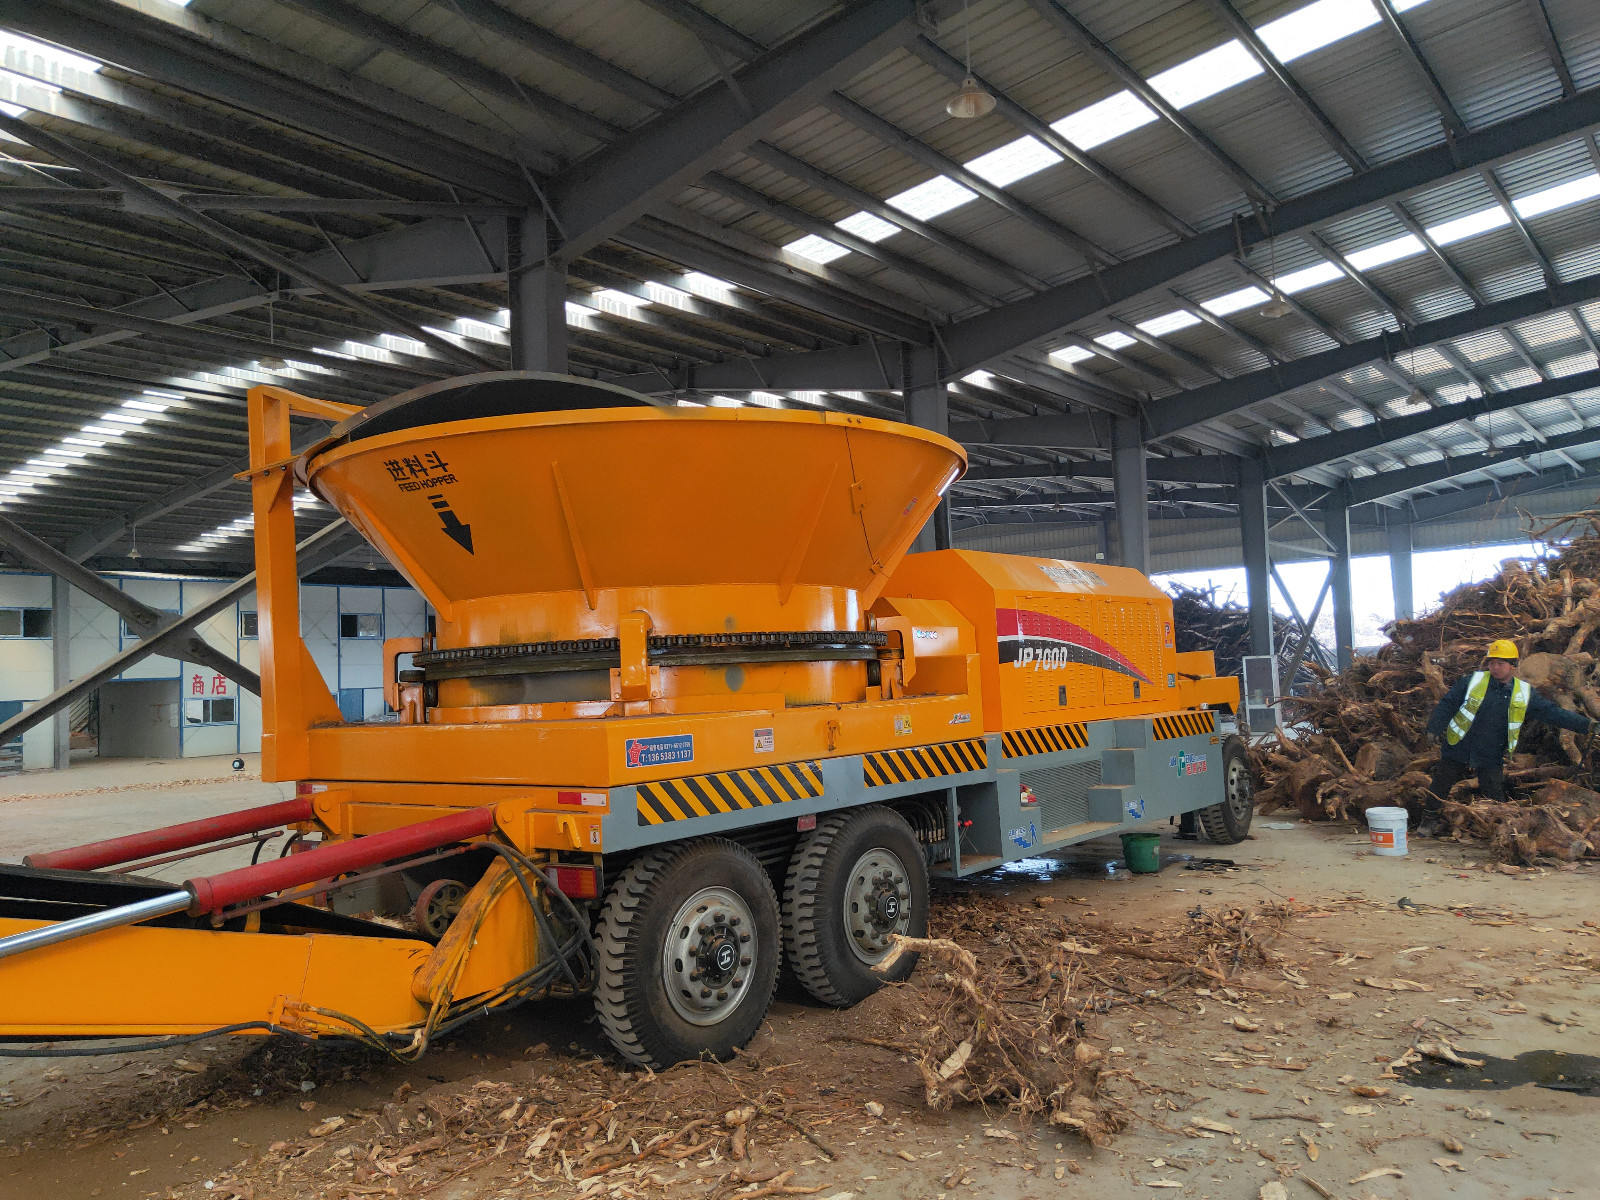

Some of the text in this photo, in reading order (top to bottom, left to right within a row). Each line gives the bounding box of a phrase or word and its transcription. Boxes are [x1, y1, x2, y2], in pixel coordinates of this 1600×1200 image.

[383, 450, 449, 482] 进料斗
[398, 473, 459, 492] FEED HOPPER
[1013, 646, 1068, 671] JP7000
[192, 673, 227, 695] 商店
[677, 749, 691, 759] 1137
